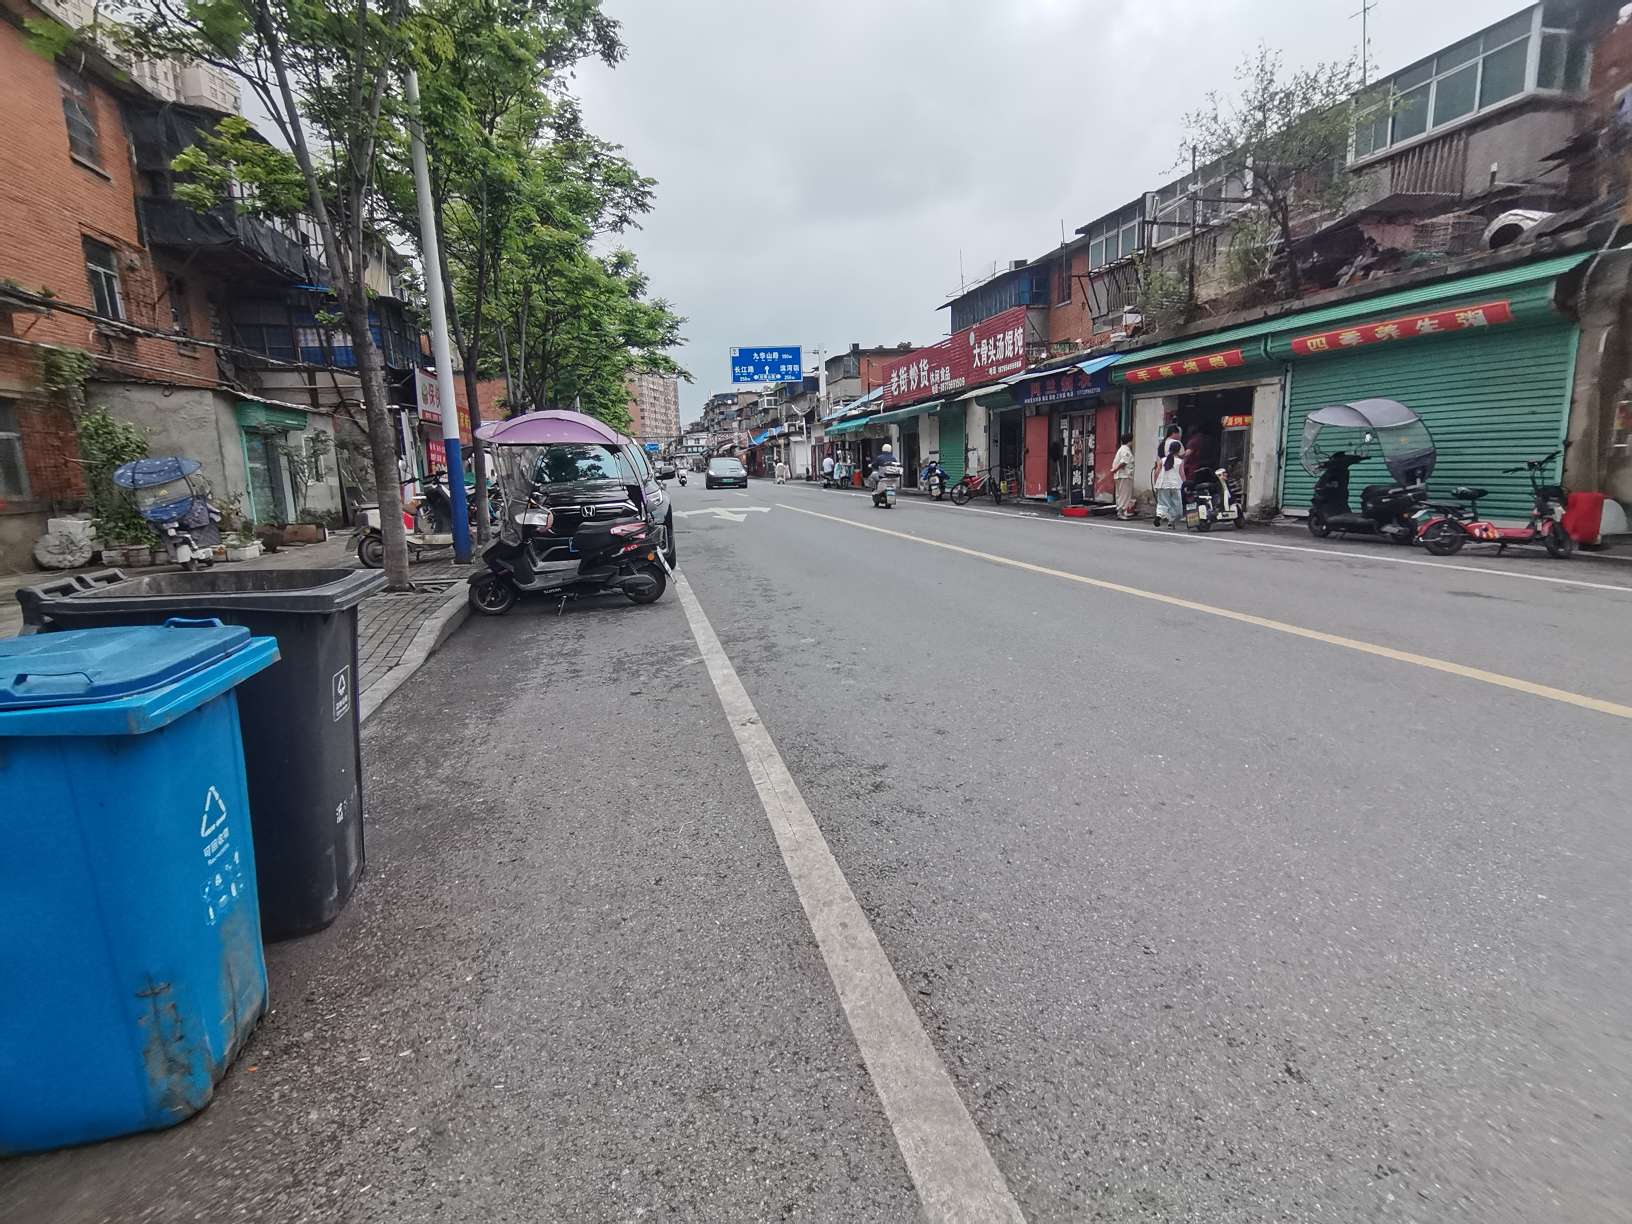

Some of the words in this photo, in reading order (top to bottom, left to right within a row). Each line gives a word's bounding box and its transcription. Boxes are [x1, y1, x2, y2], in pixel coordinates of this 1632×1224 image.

[753, 352, 779, 360] 九华山路
[973, 326, 1024, 368] 大骨头汤馄饨
[735, 365, 754, 373] 长江路
[891, 358, 929, 395] 老街炒货
